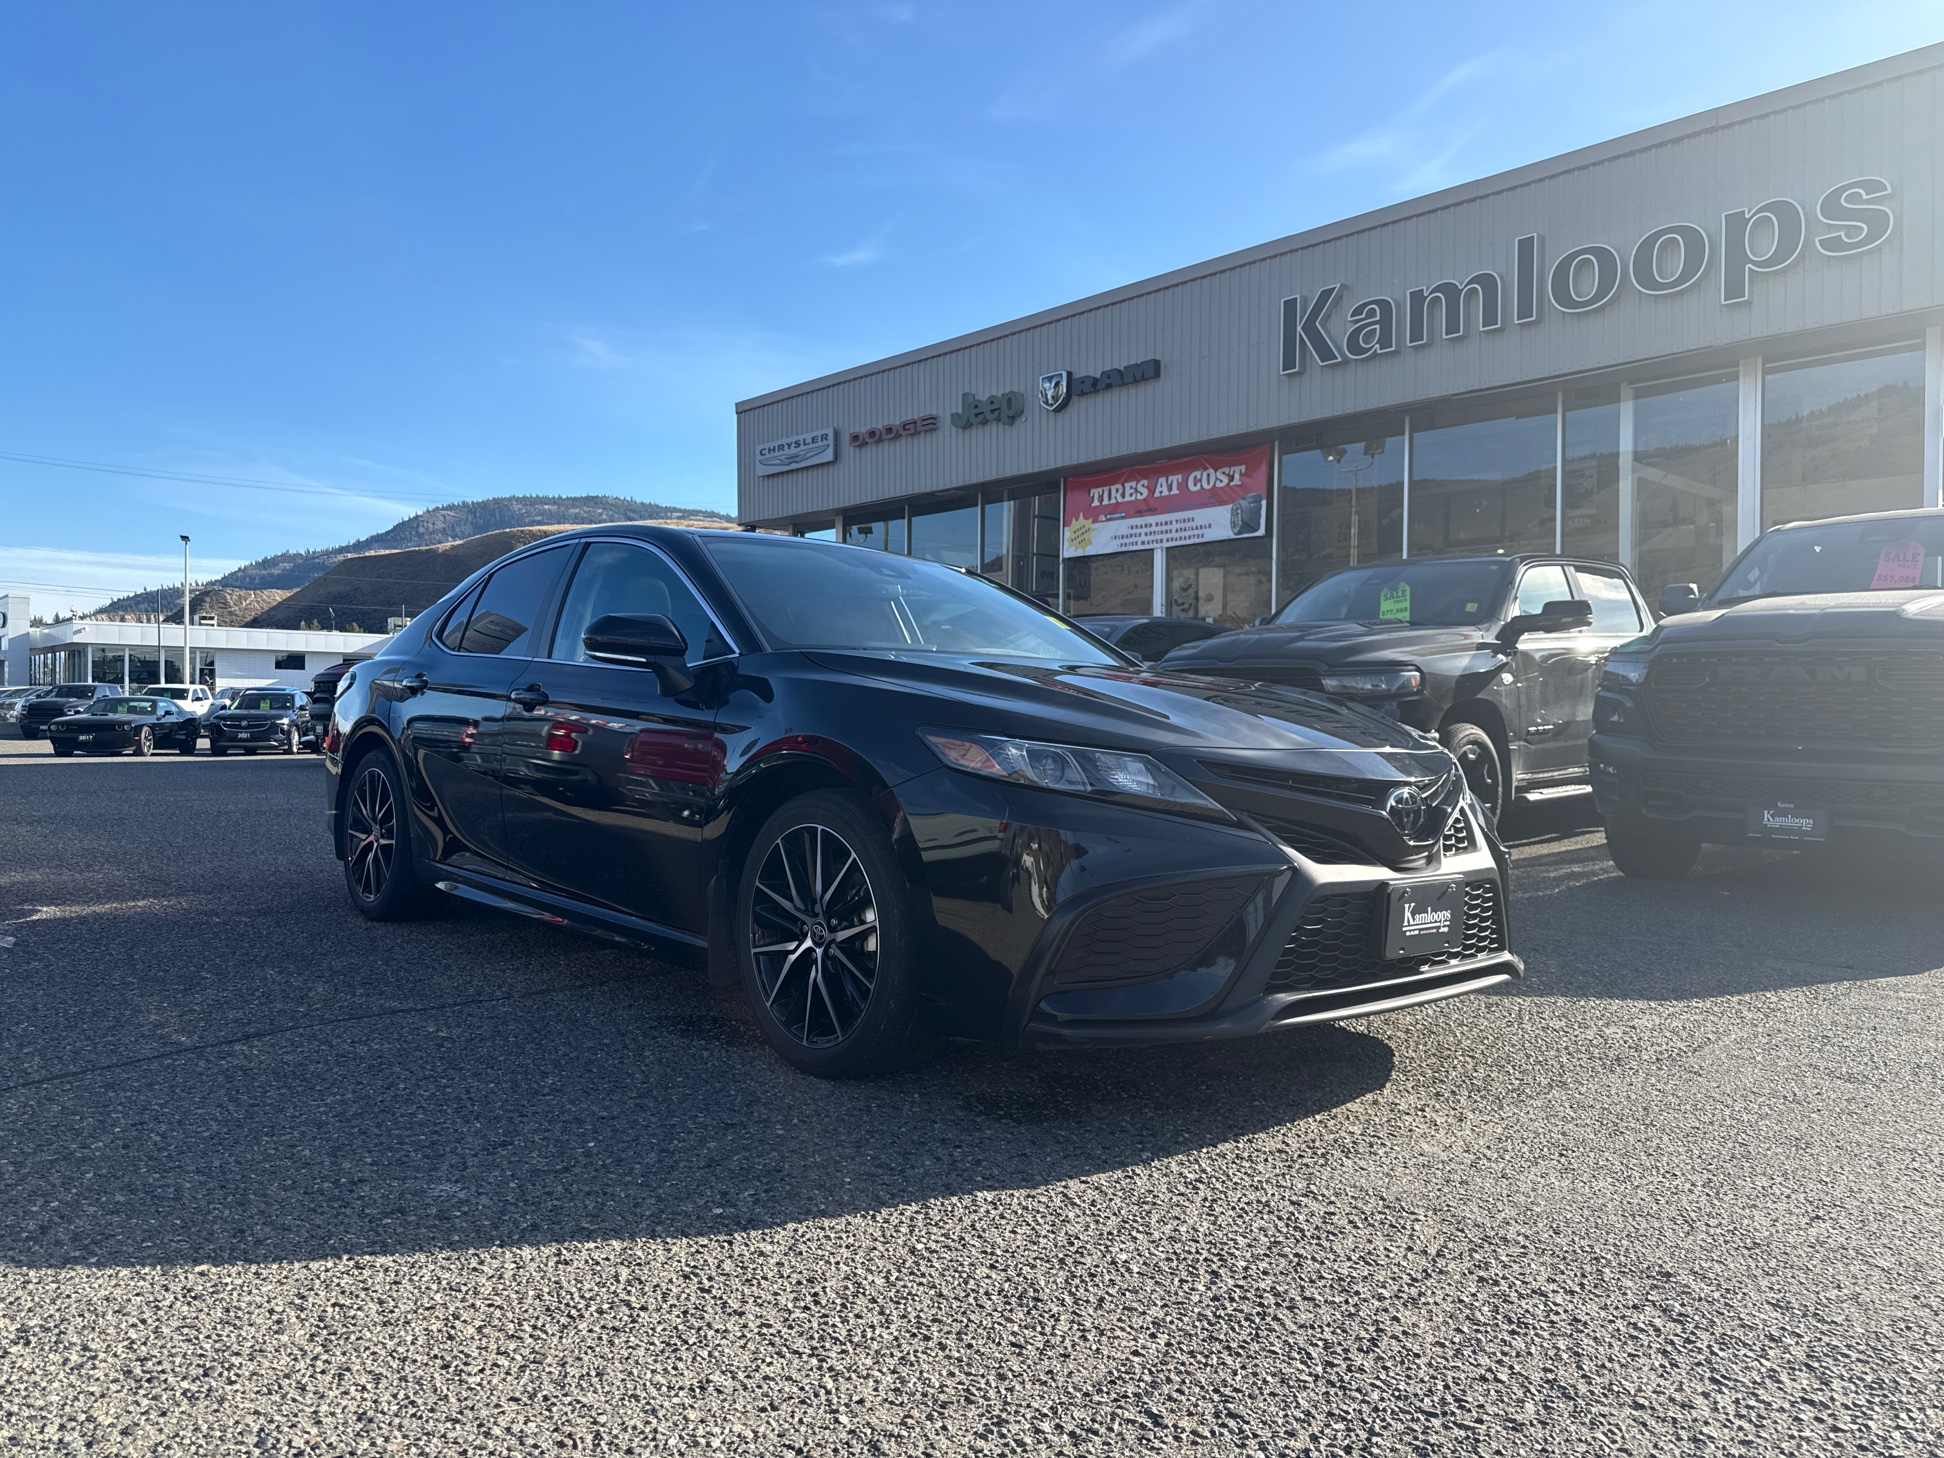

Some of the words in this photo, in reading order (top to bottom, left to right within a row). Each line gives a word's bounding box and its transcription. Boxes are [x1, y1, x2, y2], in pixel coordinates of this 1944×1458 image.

[1279, 175, 1895, 376] Kamloops
[1071, 358, 1161, 397] RAM
[951, 390, 1025, 430] Jeep
[849, 413, 940, 448] DODGE
[759, 433, 829, 457] CHRYSLER
[1090, 479, 1149, 507] TIRES
[1153, 474, 1183, 498] AT
[1187, 464, 1246, 492] COST
[1114, 532, 1142, 540] FINANCE
[1144, 528, 1173, 537] OPTIONS
[1175, 523, 1212, 533] AVAILABLE
[1130, 522, 1153, 530] BRAND
[1155, 519, 1173, 527] NAME
[1175, 517, 1195, 525] TIRES
[1120, 540, 1139, 548] PRICE
[1140, 538, 1164, 546] MATCH
[1166, 533, 1205, 543] GUARANTEE
[1882, 551, 1920, 563] SALE
[1382, 589, 1408, 602] SALE
[1715, 664, 1869, 684] RAM
[1763, 809, 1814, 829] Kamloops
[1402, 902, 1451, 927] Kamloops
